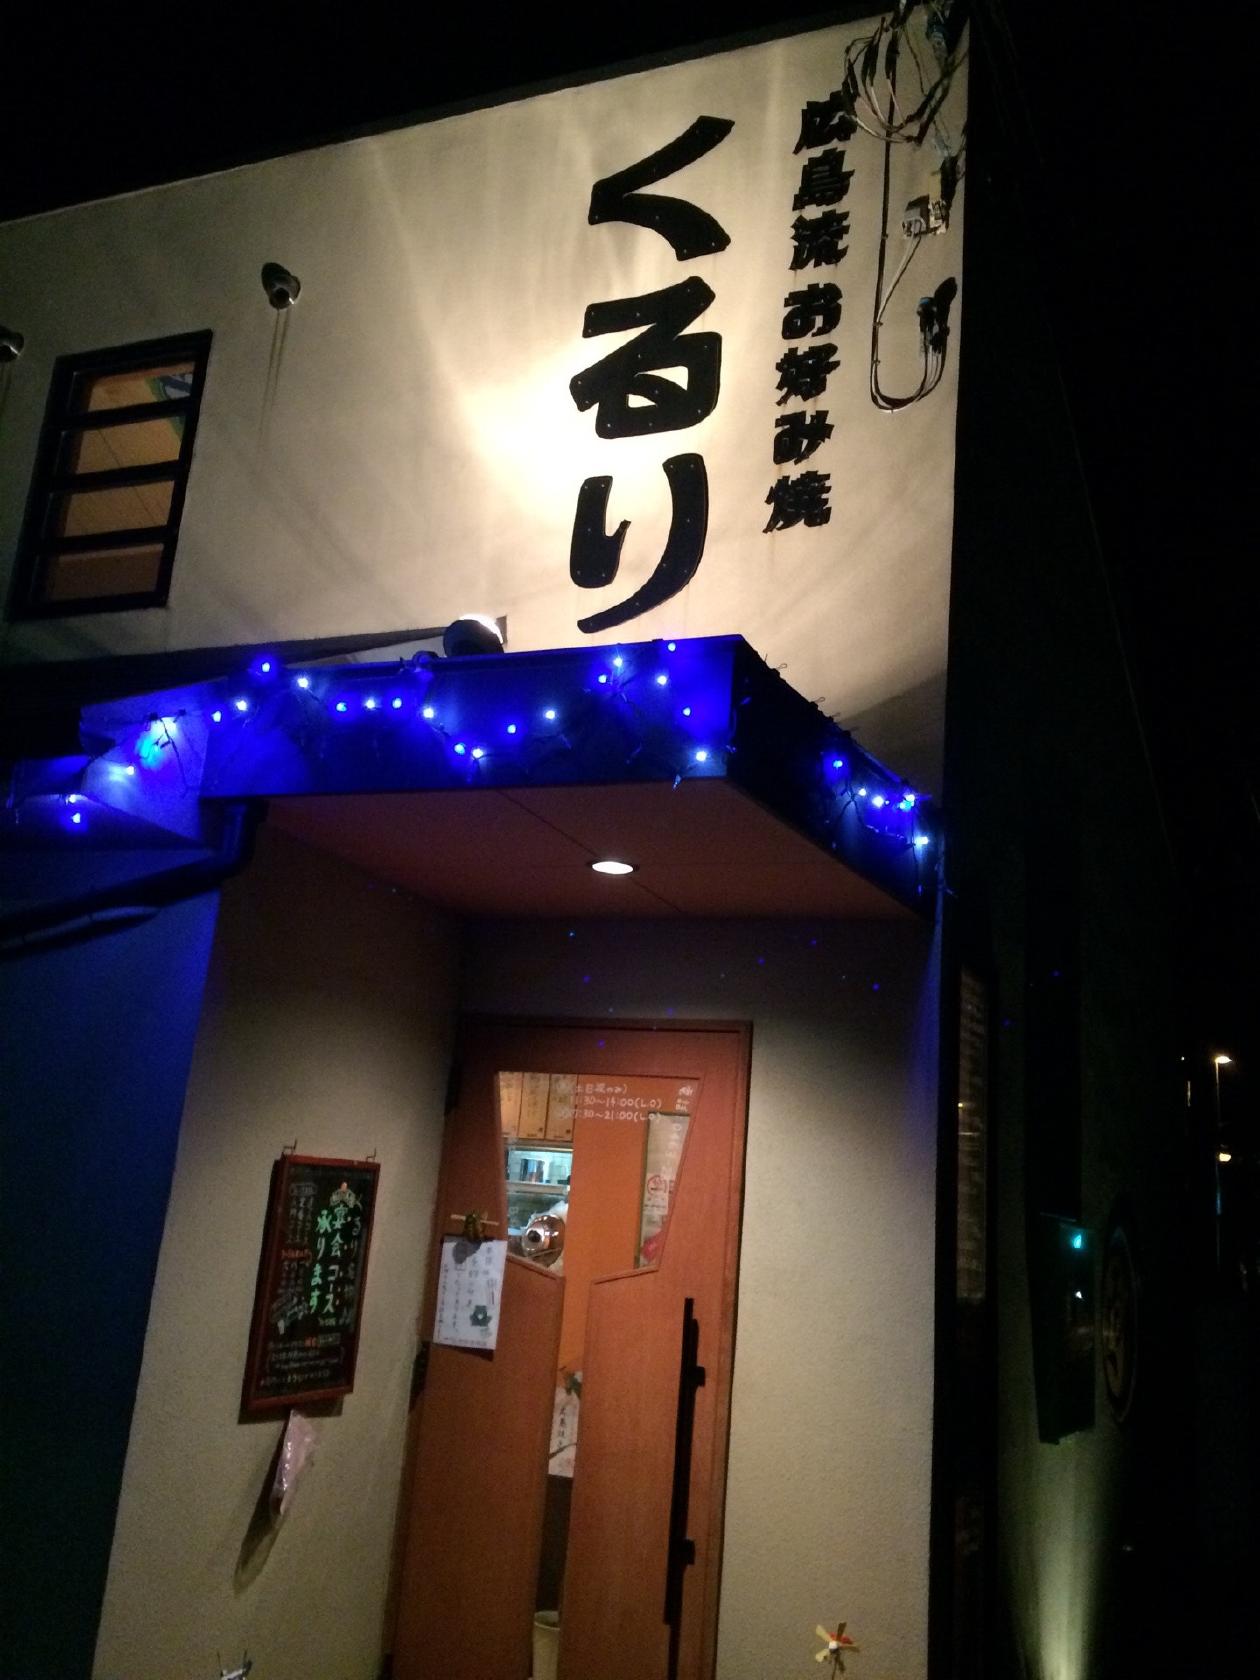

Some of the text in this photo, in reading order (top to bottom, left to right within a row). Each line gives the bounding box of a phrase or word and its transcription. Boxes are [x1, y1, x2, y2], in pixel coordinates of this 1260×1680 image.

[569, 114, 736, 634] くるり
[309, 1208, 332, 1315] 承ります
[322, 1204, 349, 1314] 宴会コース
